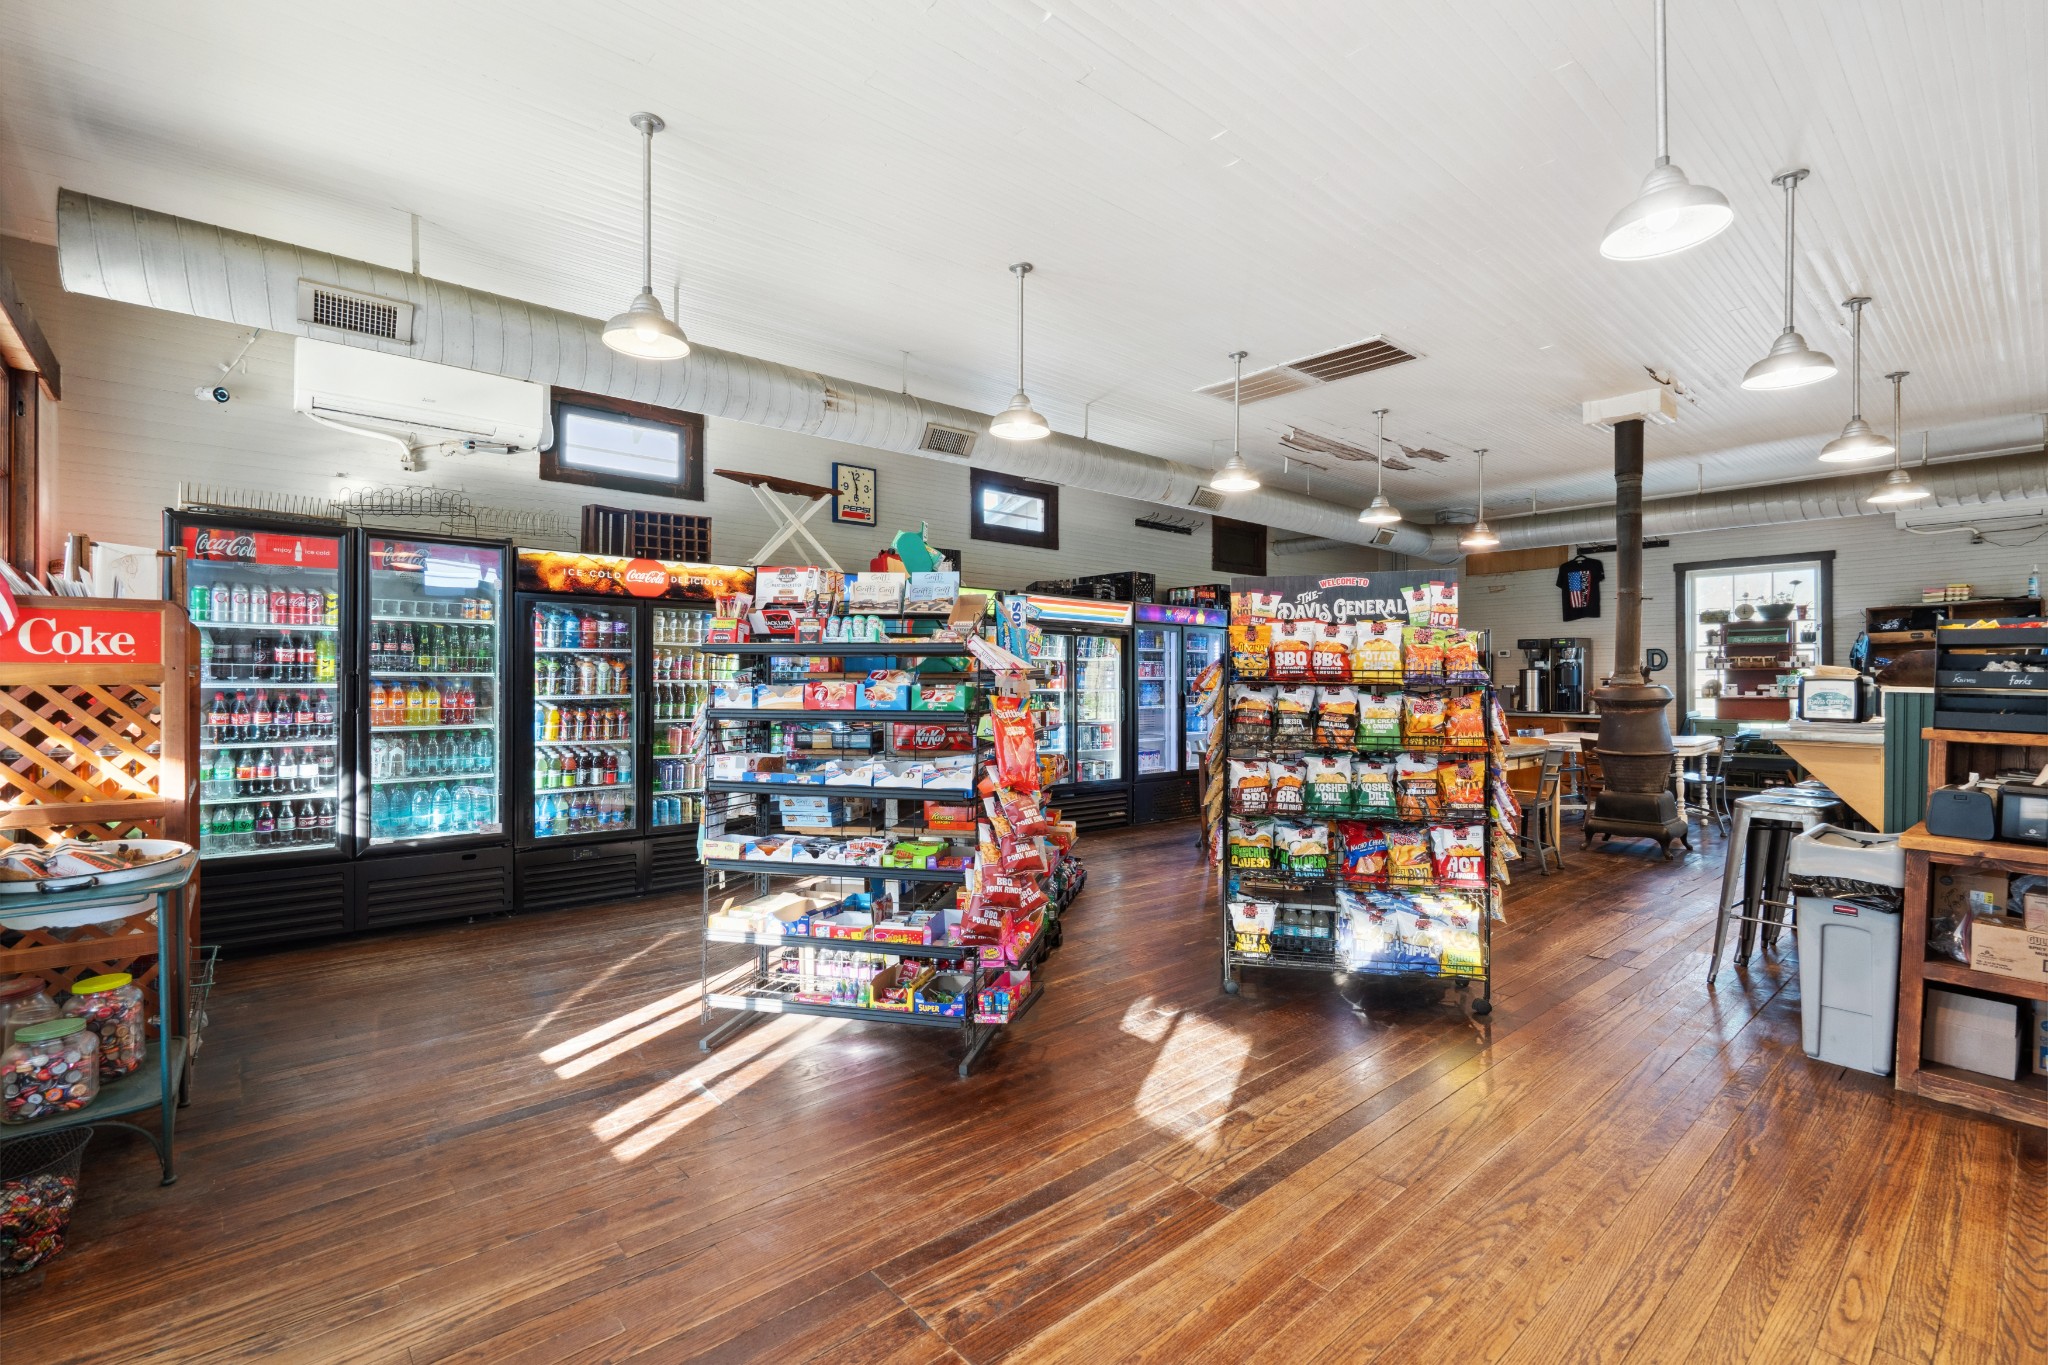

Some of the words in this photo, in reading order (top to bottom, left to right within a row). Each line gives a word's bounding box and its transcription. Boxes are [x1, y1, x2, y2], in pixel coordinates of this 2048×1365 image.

[864, 485, 870, 493] 3
[842, 504, 871, 514] PEPSI
[195, 533, 257, 558] Coca-Cola
[563, 568, 583, 577] ICE
[590, 570, 622, 579] COLD
[626, 569, 667, 585] Coca-Cola
[671, 576, 724, 587] DELICIOUS
[1319, 577, 1357, 588] WELCOME
[1358, 578, 1369, 588] TO
[1295, 590, 1321, 604] THE
[1277, 601, 1332, 624] DAVIS
[1333, 598, 1408, 624] GENERAL
[1430, 612, 1458, 624] HOT
[18, 618, 136, 656] Coke
[1274, 652, 1307, 666] BBQ
[1312, 651, 1344, 666] BBQ
[1360, 650, 1399, 660] POTATO
[1646, 648, 1668, 672] D
[1364, 662, 1394, 670] CHIPS
[1314, 784, 1348, 792] KOSHER
[1322, 792, 1342, 801] DILL
[1368, 792, 1390, 801] DILL
[1024, 808, 1038, 818] BBQ
[1016, 843, 1030, 853] BBQ
[1248, 846, 1270, 858] CHILE
[1350, 842, 1368, 852] NACHO
[1007, 852, 1024, 862] PORK
[1238, 858, 1270, 868] QUESO
[1447, 857, 1481, 872] HOT
[996, 877, 1013, 886] BBQ
[1004, 886, 1022, 894] RINDS
[984, 910, 998, 920] BBQ
[972, 916, 988, 925] PORK
[1260, 935, 1266, 944] &
[918, 1004, 940, 1012] SUPER
